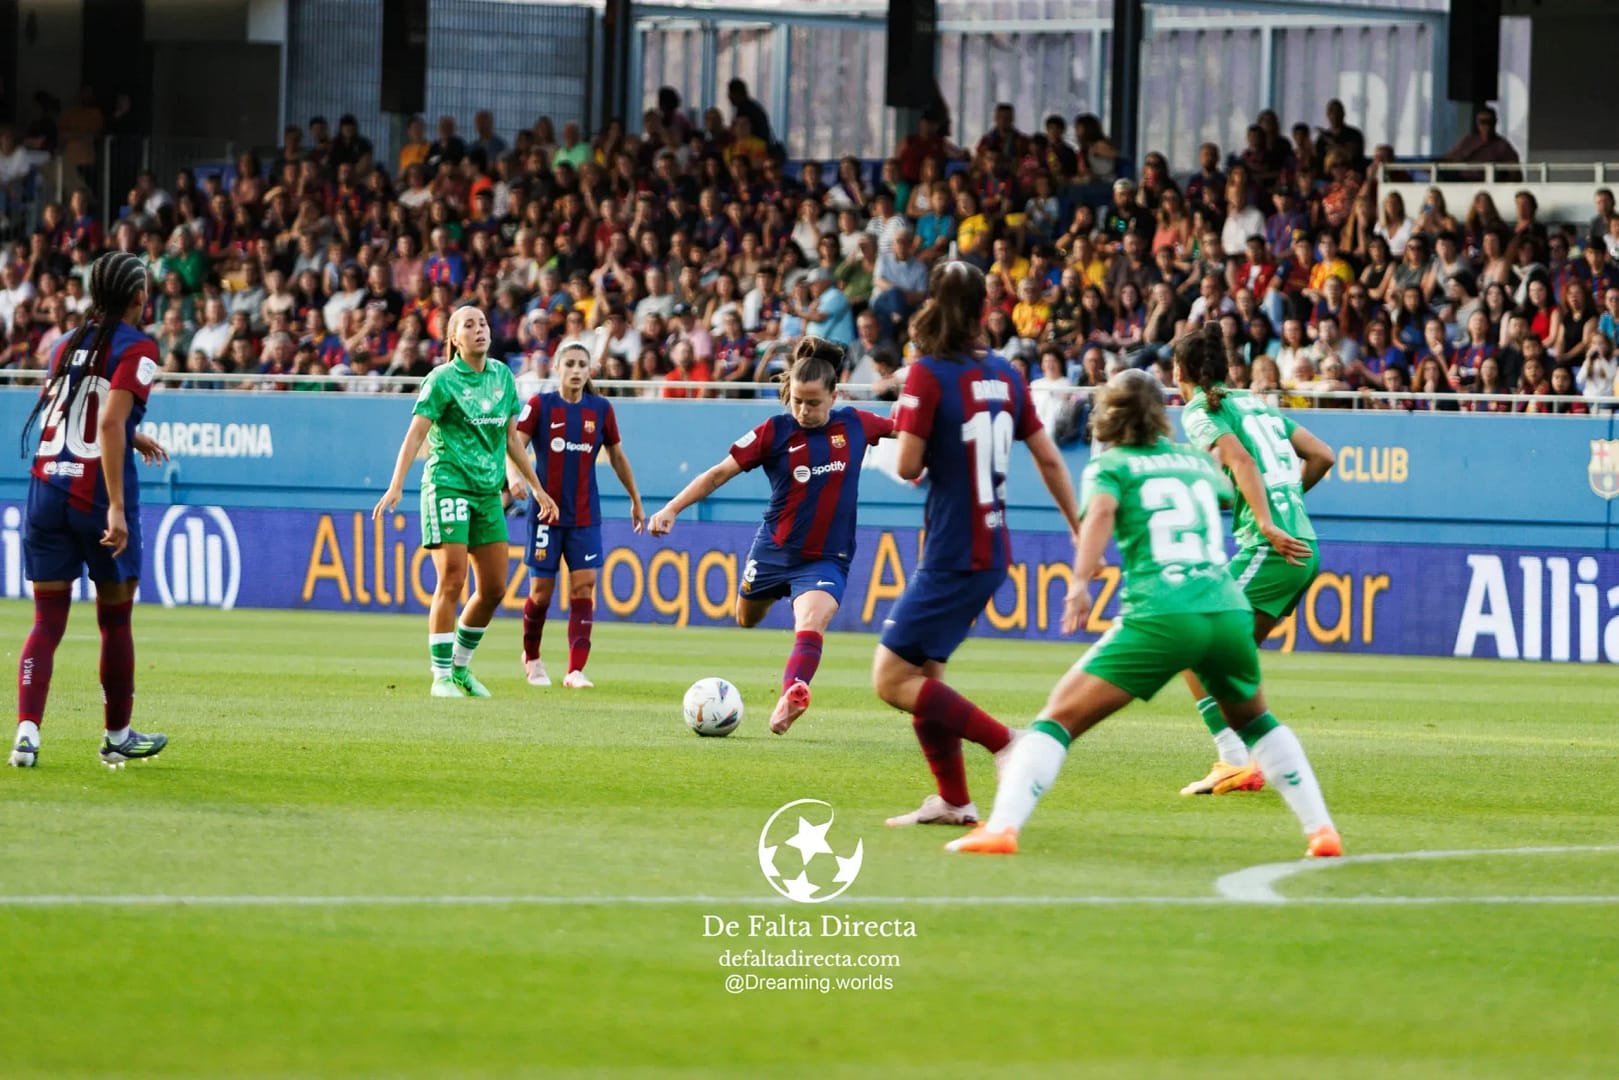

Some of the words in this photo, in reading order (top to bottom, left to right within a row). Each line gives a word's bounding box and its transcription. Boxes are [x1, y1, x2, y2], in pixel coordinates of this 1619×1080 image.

[1242, 411, 1303, 488] 15
[1338, 446, 1408, 483] CLUB
[440, 497, 468, 523] 22
[1140, 476, 1228, 566] 21
[535, 524, 550, 548] 5
